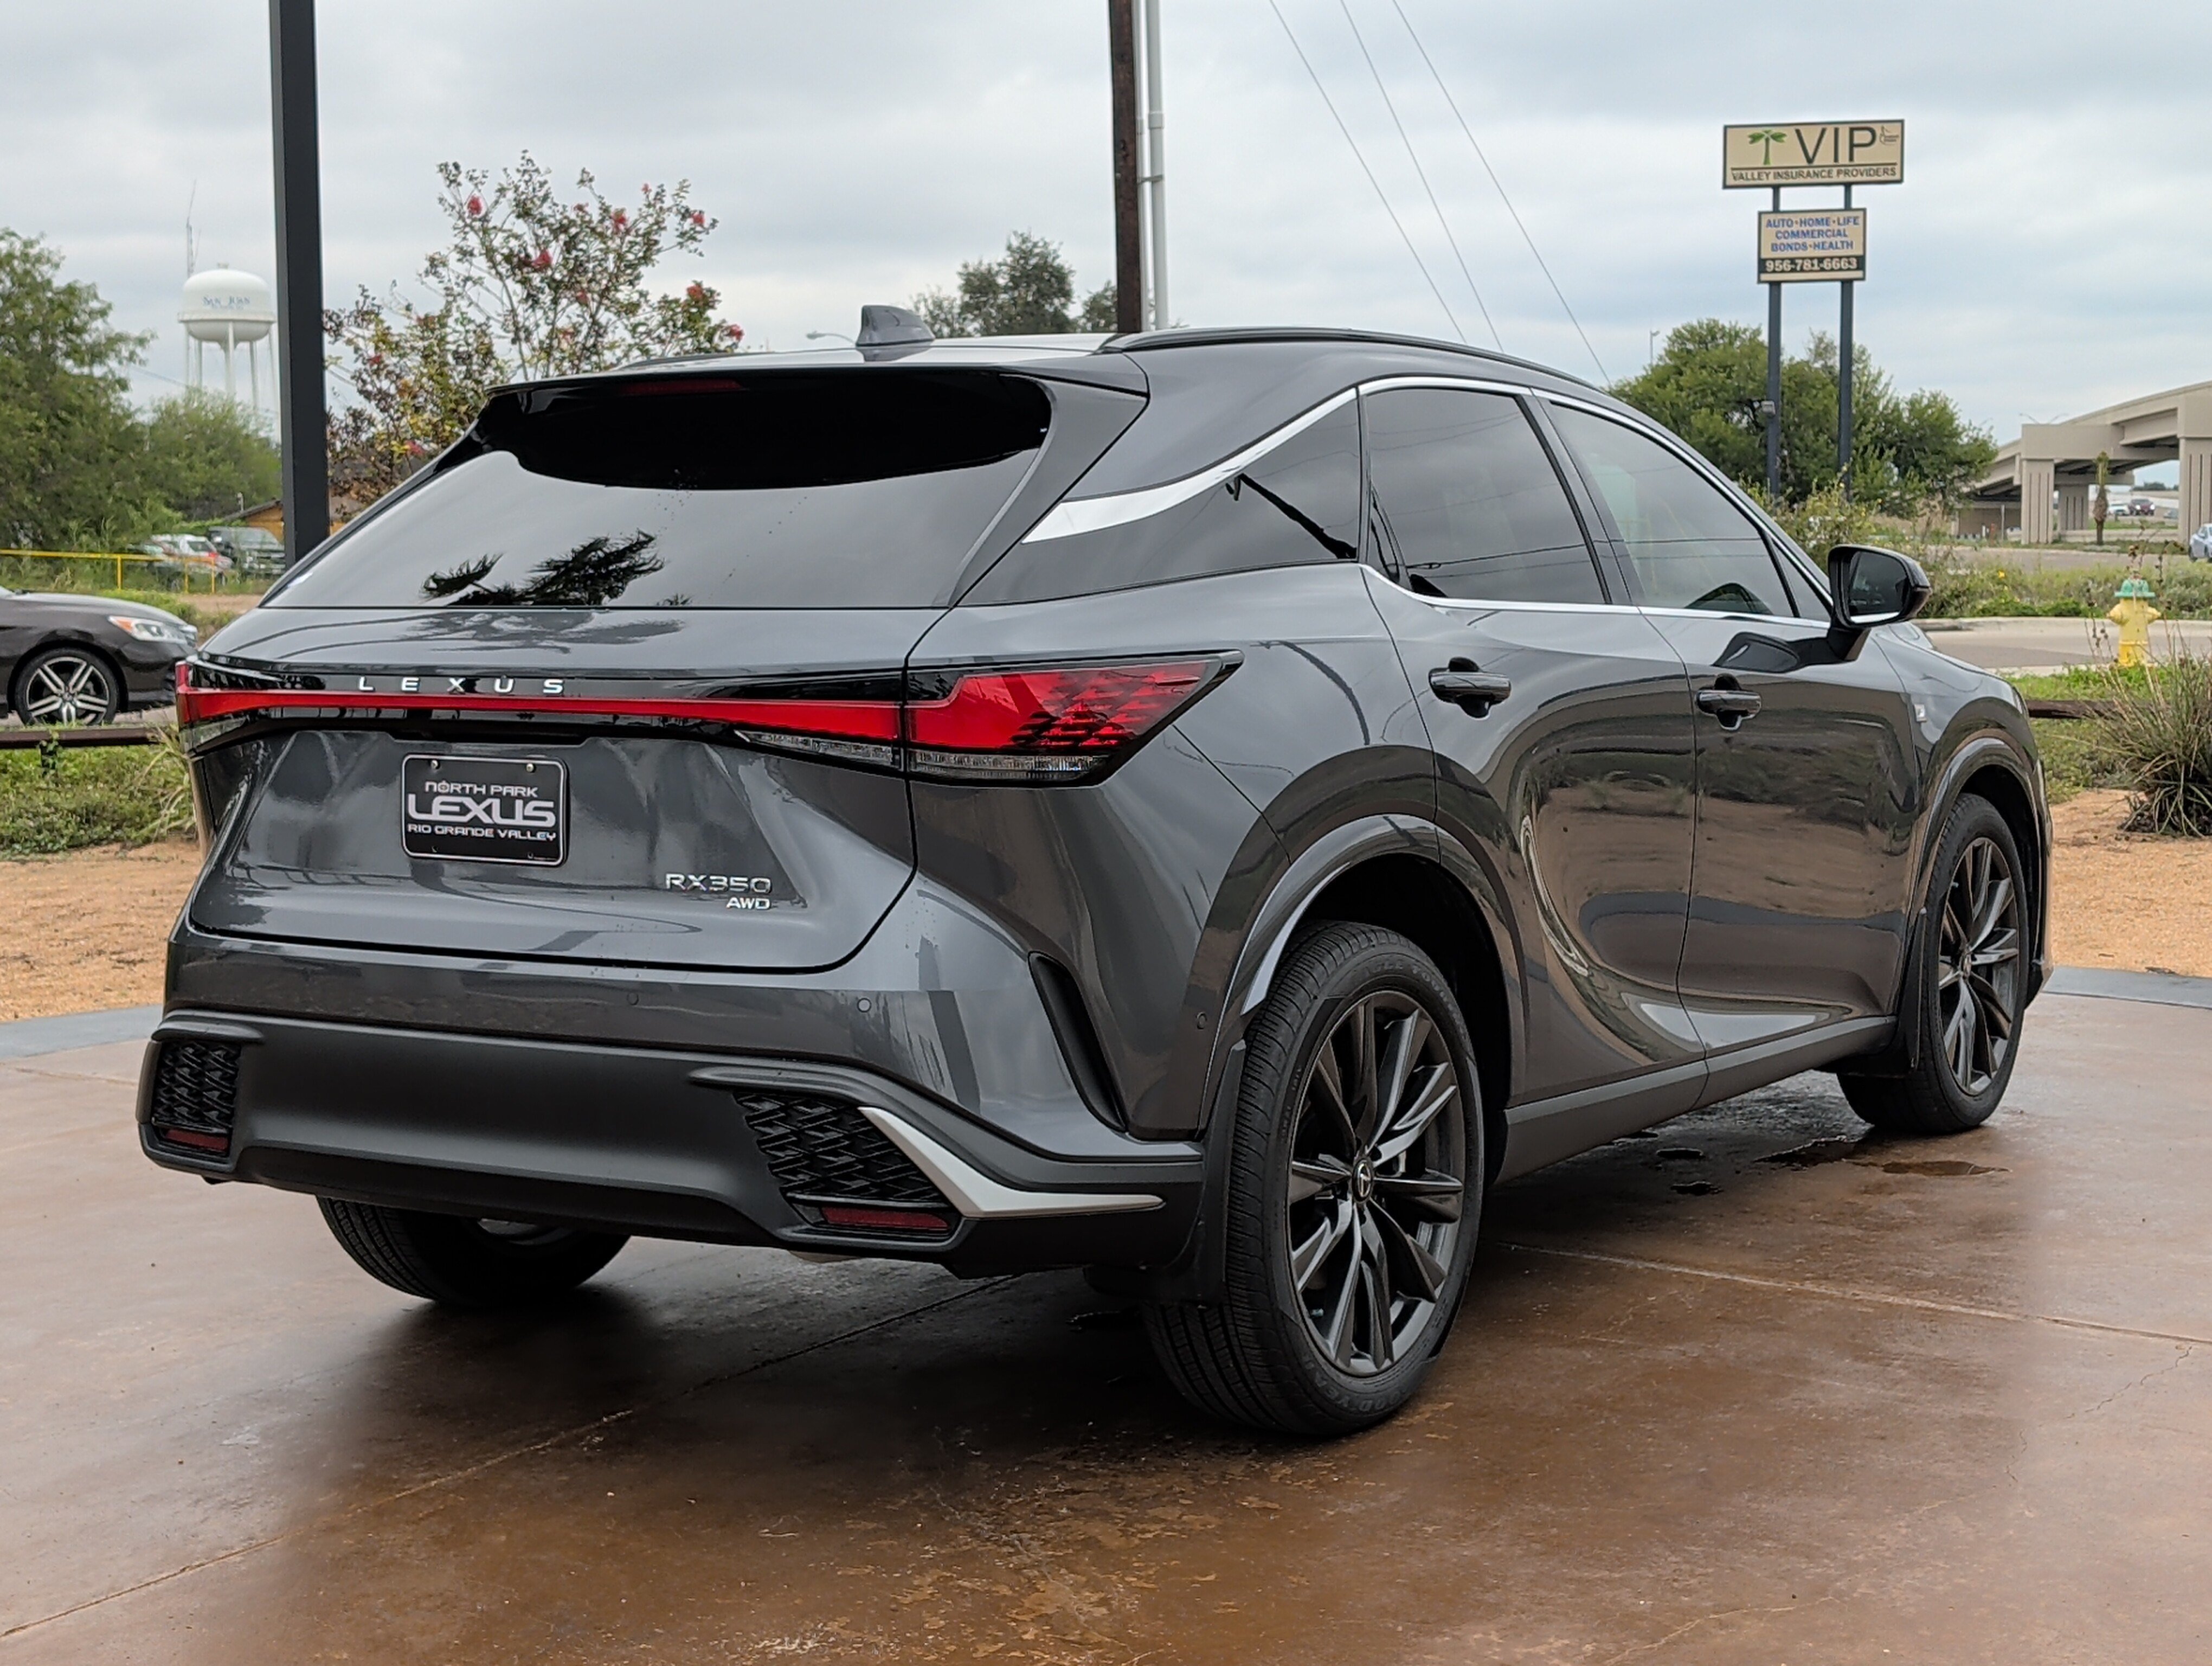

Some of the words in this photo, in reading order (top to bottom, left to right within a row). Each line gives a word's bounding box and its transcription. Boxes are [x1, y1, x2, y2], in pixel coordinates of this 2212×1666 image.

[1795, 126, 1877, 164] VIP
[1731, 171, 1771, 181] VALLEY
[1773, 169, 1833, 180] INSURANCE
[1836, 167, 1896, 178] PROVIDERS
[1775, 228, 1848, 240] COMMERCIAL
[1765, 257, 1858, 272] 956-781-6663
[358, 676, 564, 694] LEXUS
[425, 780, 486, 795] NORTH
[490, 785, 539, 798] PARK
[408, 793, 556, 828] LEXUS
[408, 823, 432, 834] RIO
[435, 825, 494, 838] GRANDE
[498, 829, 557, 841] VALLEY
[665, 873, 771, 894] RX350
[726, 896, 770, 910] AWD
